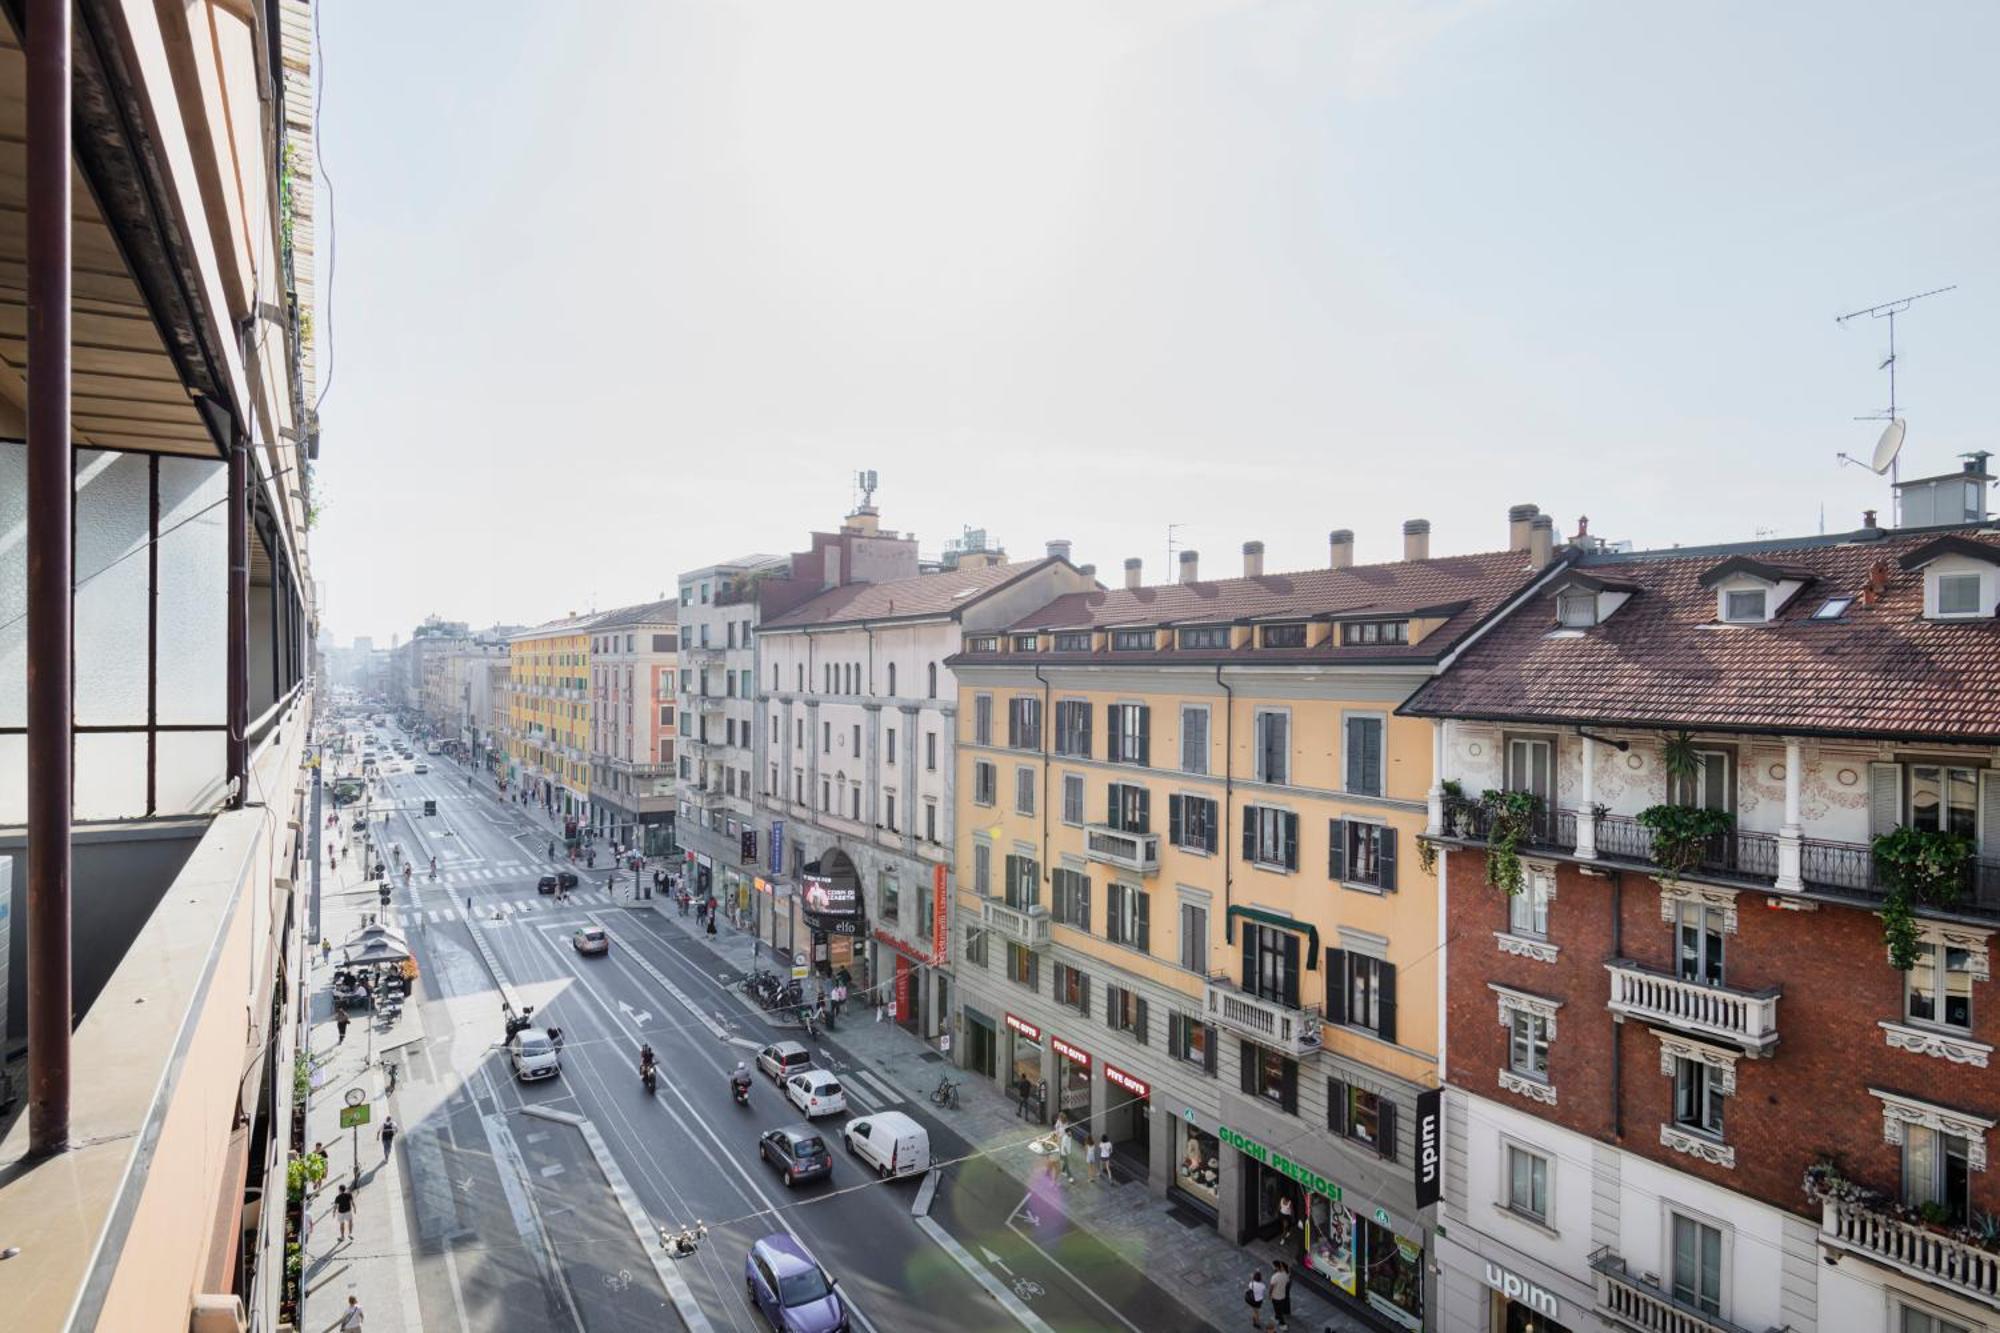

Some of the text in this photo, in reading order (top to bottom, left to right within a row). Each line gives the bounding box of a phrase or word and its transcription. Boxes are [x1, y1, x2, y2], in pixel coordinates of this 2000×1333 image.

[836, 921, 856, 933] elfo
[1068, 1048, 1087, 1064] GUYS
[1106, 1067, 1145, 1095] FIVE GUYS
[1219, 1126, 1342, 1202] GIOCHI PREZIOSI
[1422, 1114, 1439, 1184] upim
[1486, 1262, 1557, 1317] upim
